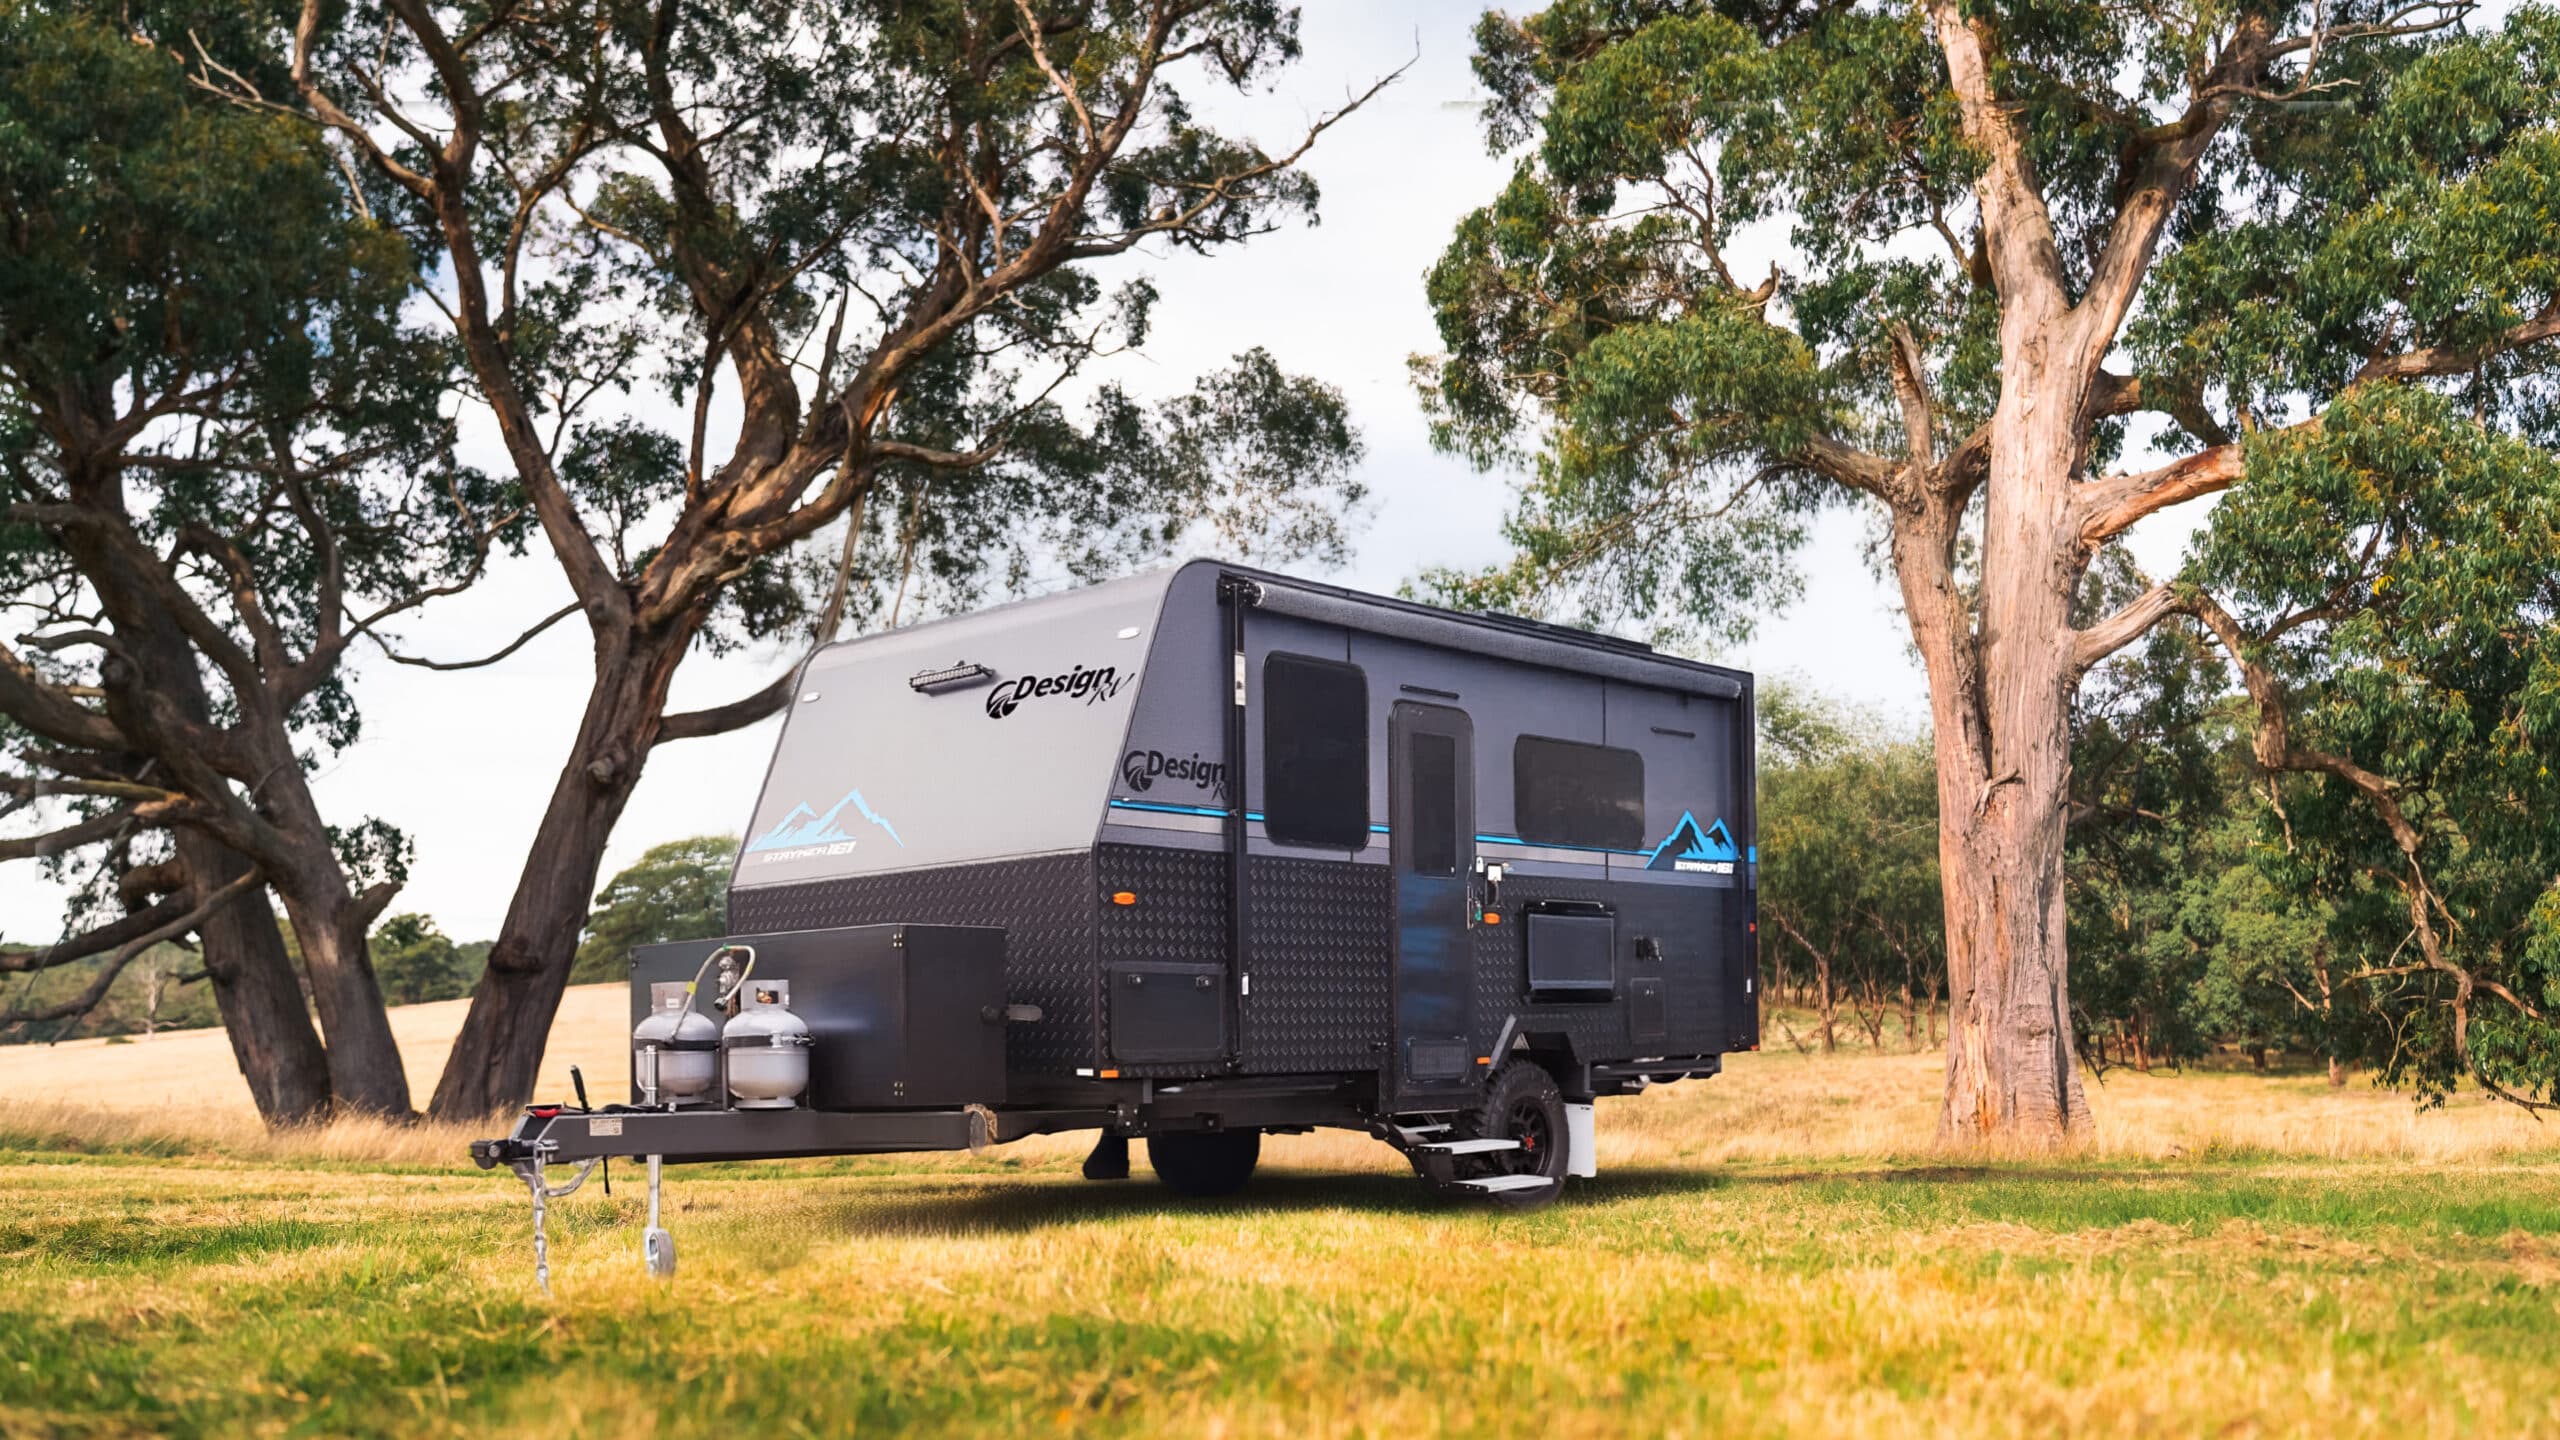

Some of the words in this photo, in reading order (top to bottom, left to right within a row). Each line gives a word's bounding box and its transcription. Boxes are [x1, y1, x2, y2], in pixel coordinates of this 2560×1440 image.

[1012, 664, 1116, 700] Design
[1087, 672, 1136, 707] RV
[1146, 750, 1226, 789] Design
